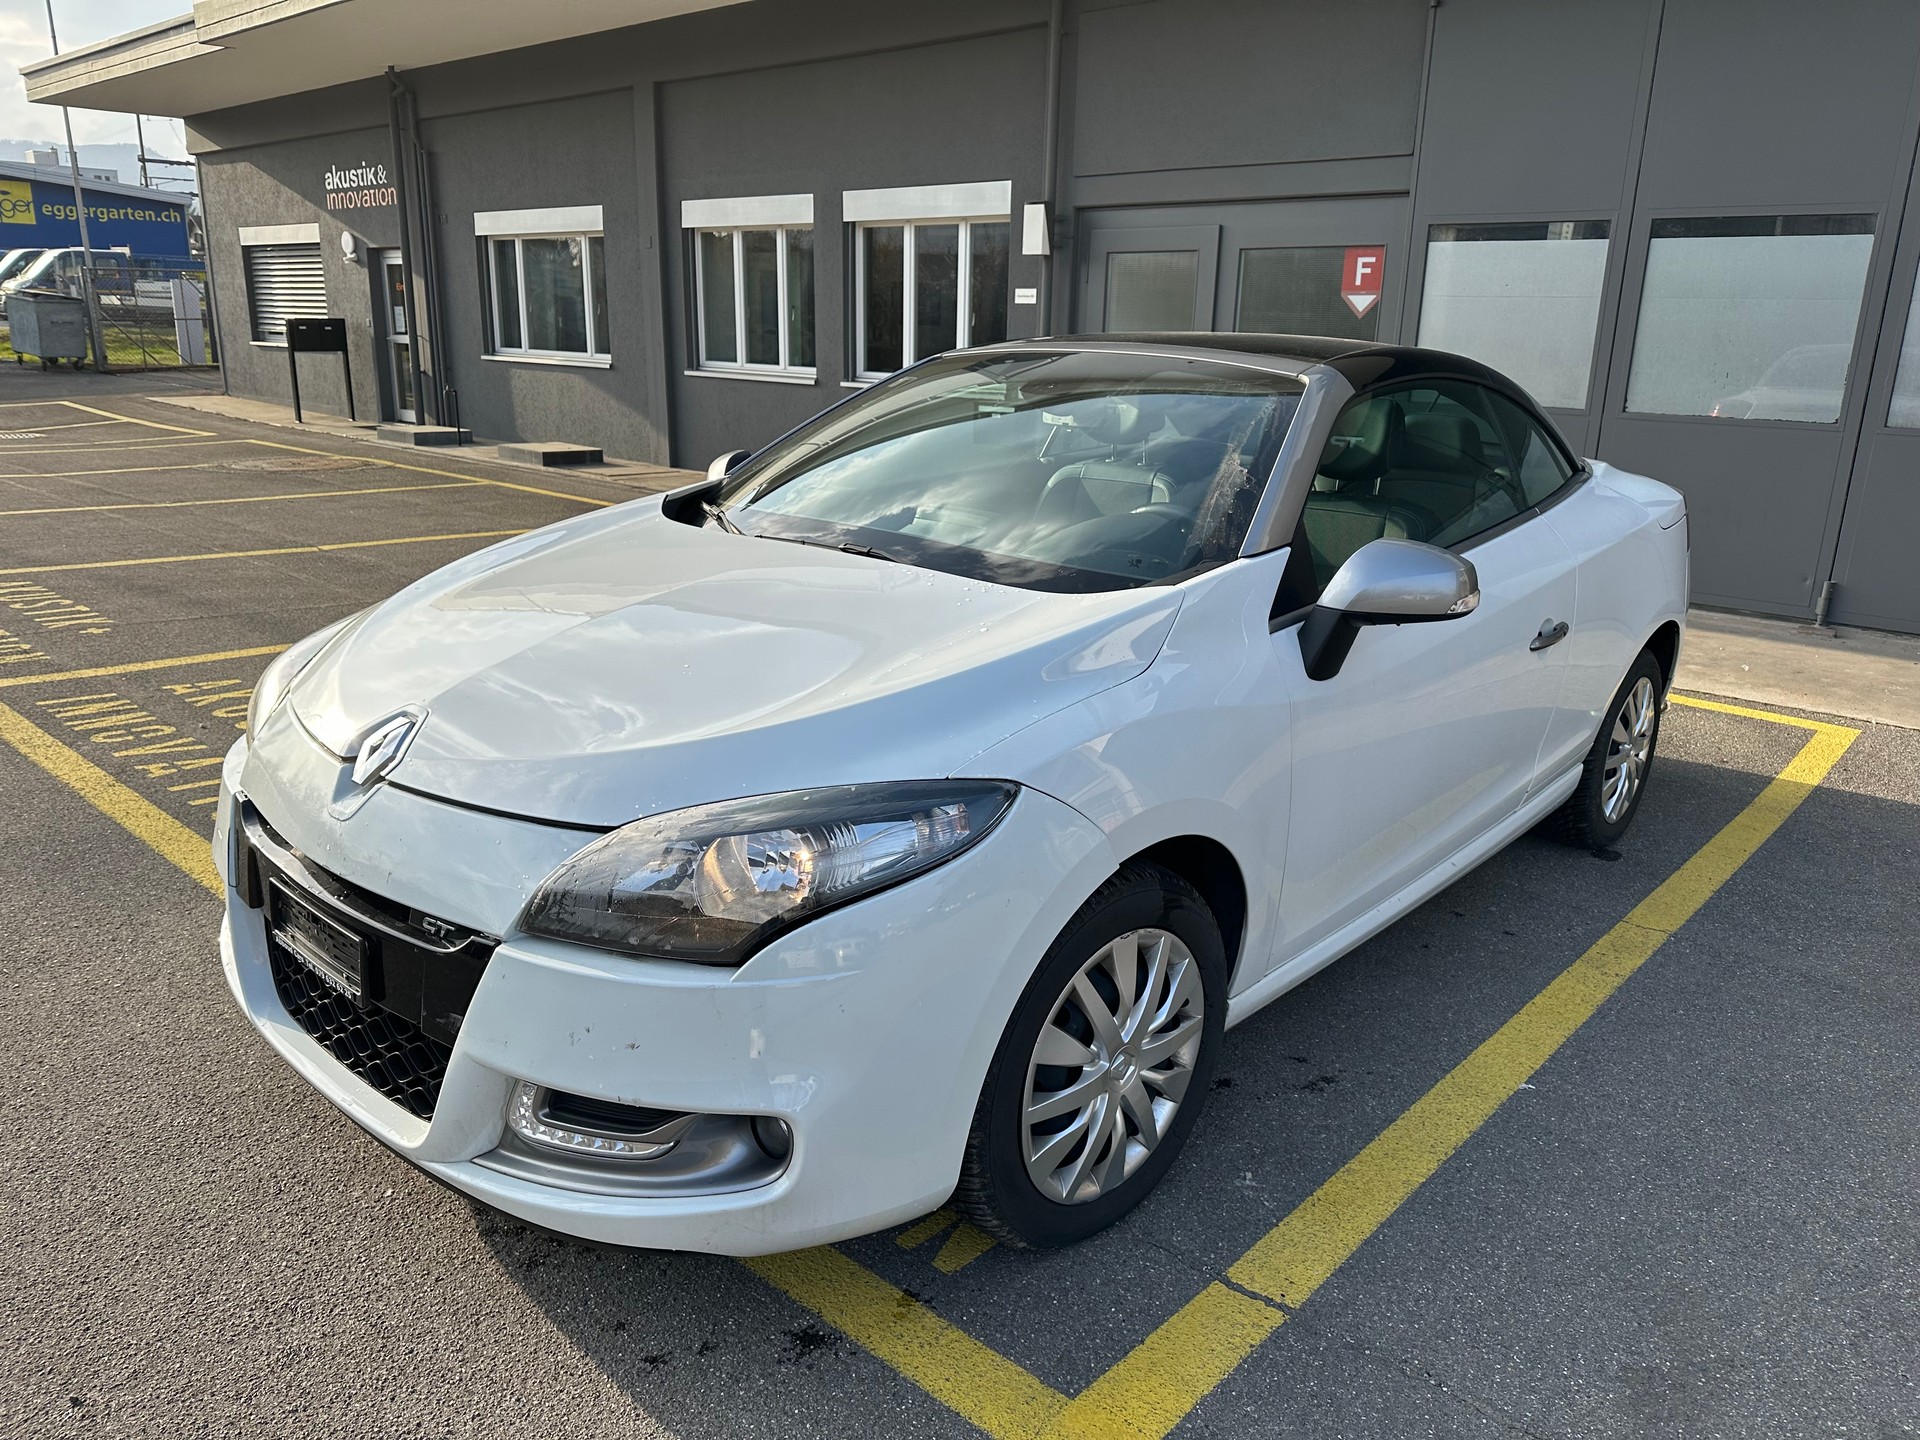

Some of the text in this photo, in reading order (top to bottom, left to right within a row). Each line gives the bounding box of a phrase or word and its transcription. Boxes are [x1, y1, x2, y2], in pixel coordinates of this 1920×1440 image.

[327, 187, 397, 210] innovation
[42, 204, 181, 223] eggergarten.ch
[1355, 257, 1376, 286] F
